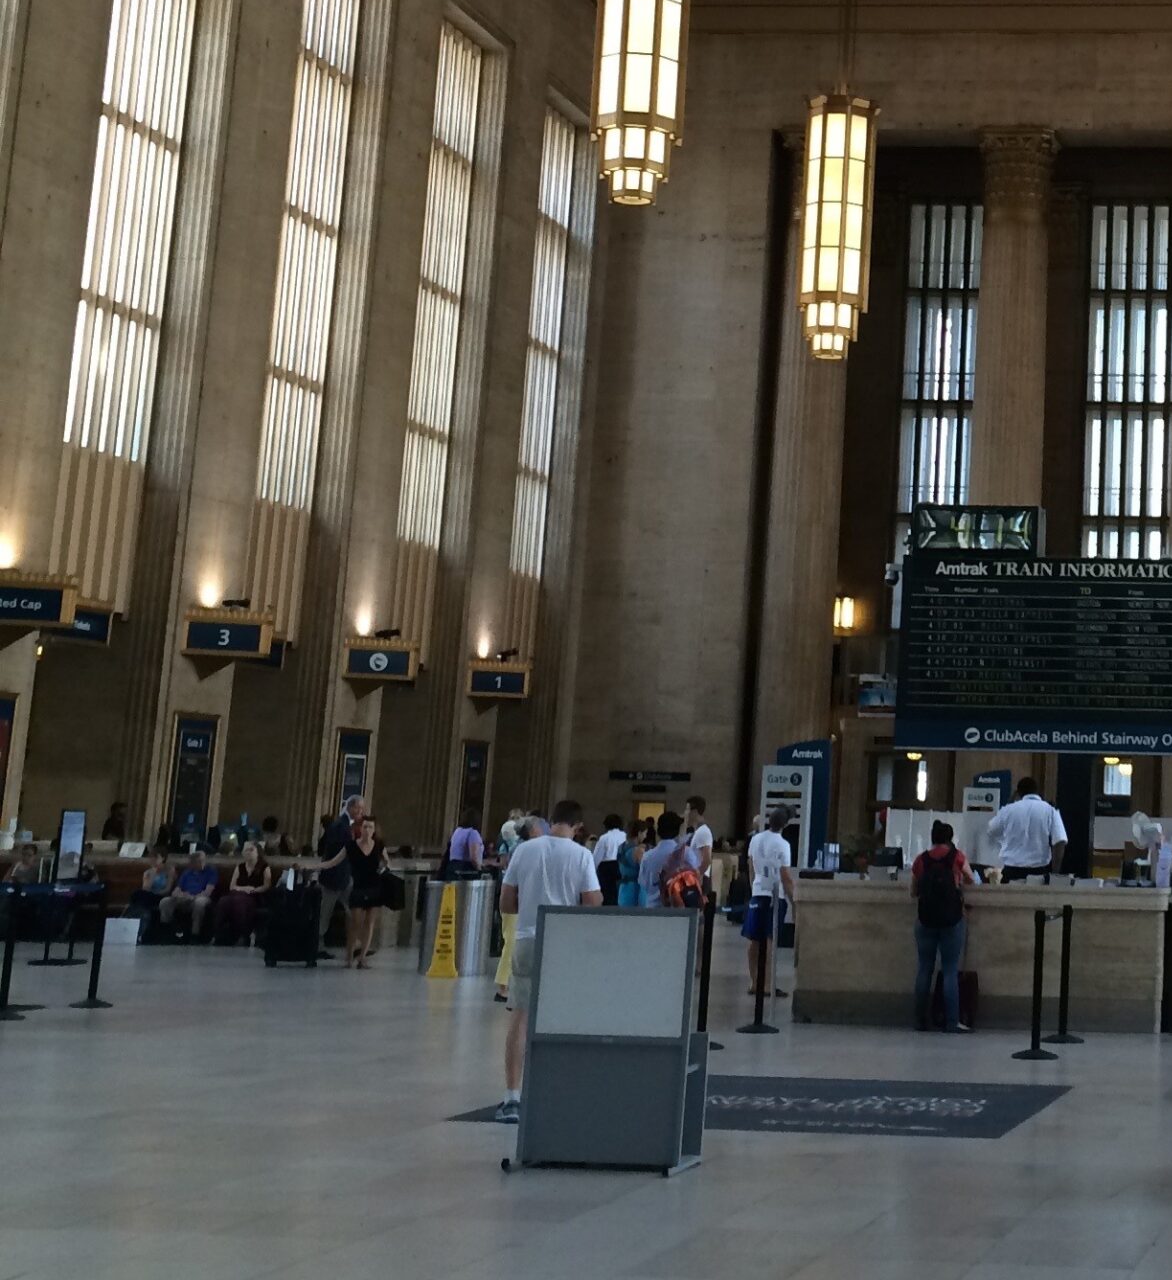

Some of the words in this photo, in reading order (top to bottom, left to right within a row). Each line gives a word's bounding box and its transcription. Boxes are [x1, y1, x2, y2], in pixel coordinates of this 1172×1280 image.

[935, 561, 988, 577] Amtrak
[992, 561, 1053, 578] TRAIN
[1079, 587, 1092, 595] TO
[0, 598, 17, 609] ed
[21, 599, 42, 611] Cap
[217, 629, 230, 646] 3
[494, 676, 502, 689] 1
[984, 729, 1048, 744] ClubAcela
[1052, 730, 1097, 744] Behind
[1101, 731, 1158, 749] Stairway
[792, 748, 823, 759] Amtrak
[767, 774, 788, 785] Gate
[967, 793, 984, 801] Gate
